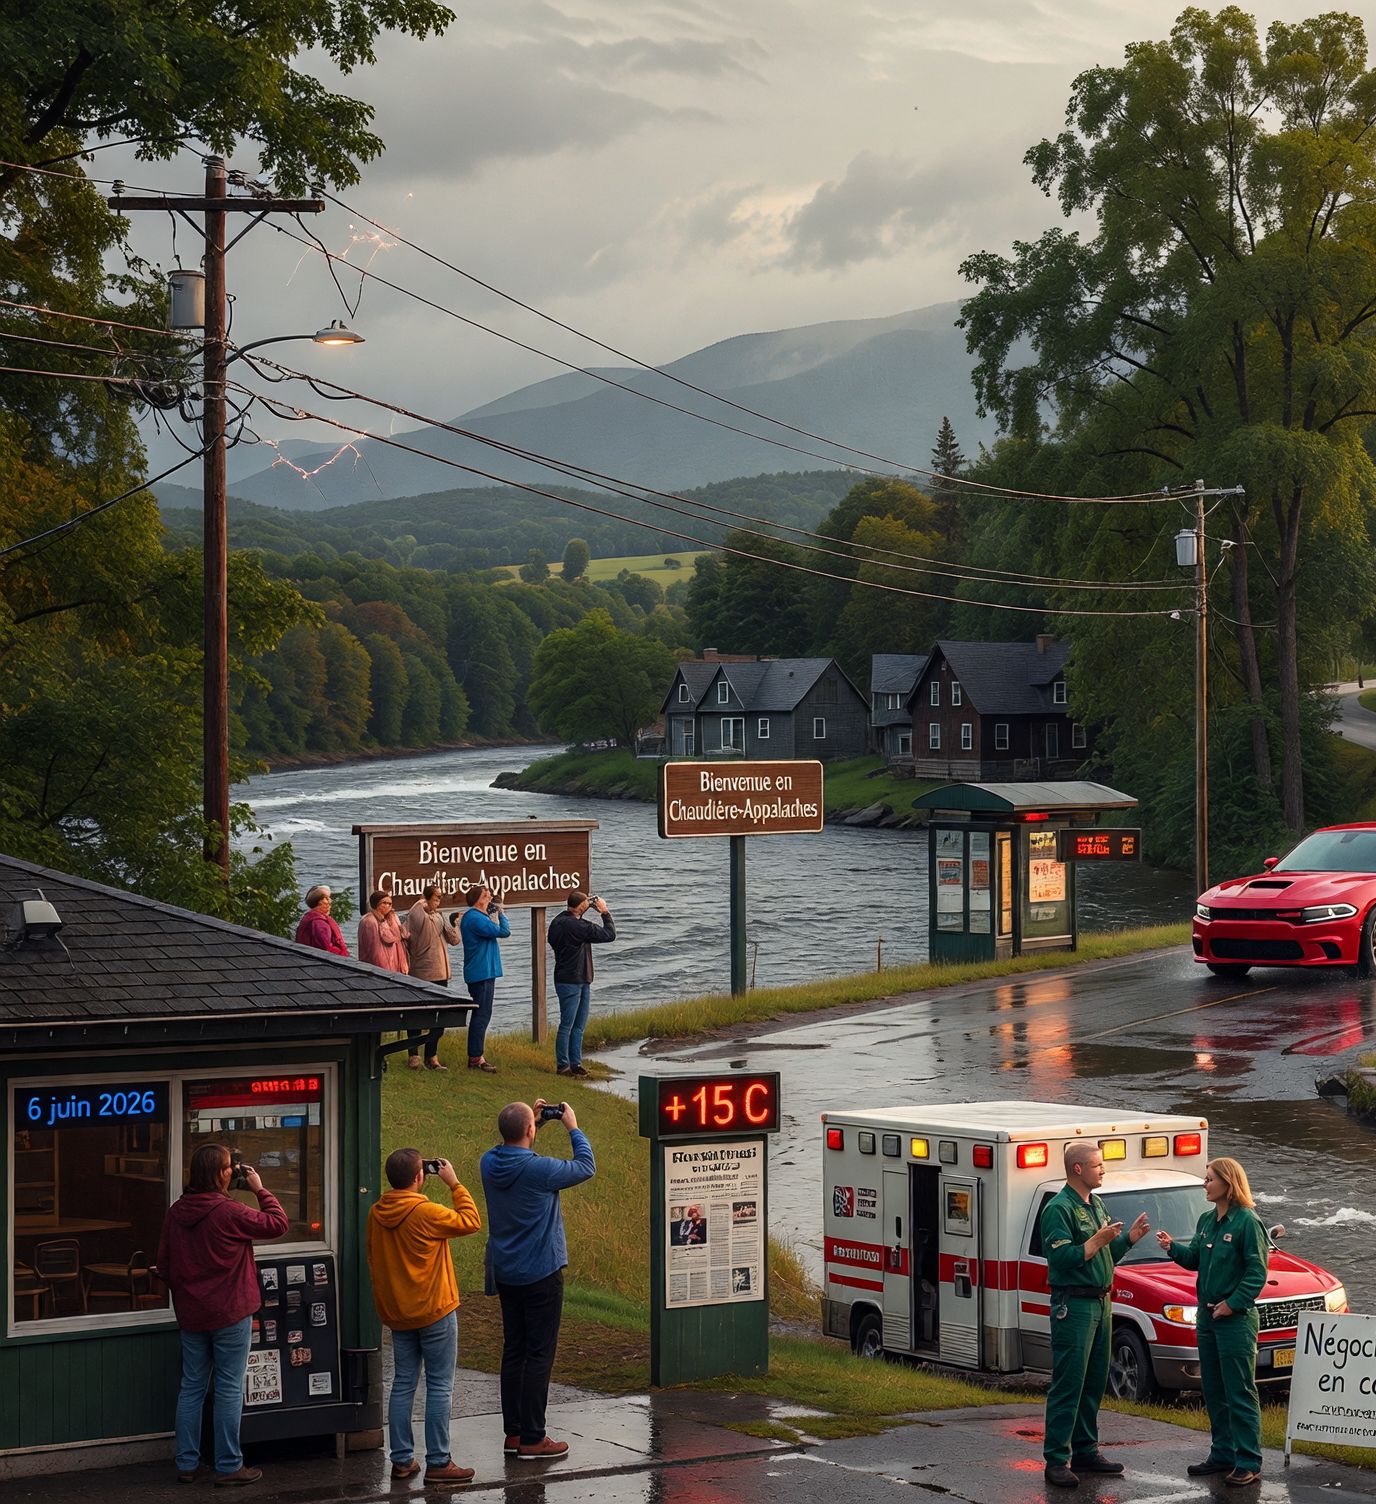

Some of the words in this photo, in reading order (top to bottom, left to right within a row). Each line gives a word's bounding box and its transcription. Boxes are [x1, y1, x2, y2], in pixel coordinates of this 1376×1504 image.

[700, 771, 771, 792] Bienvenue
[775, 776, 792, 791] en
[419, 840, 518, 864] Bienvenue
[524, 843, 546, 861] en
[28, 1097, 42, 1120] 6
[48, 1095, 91, 1125] juin
[99, 1091, 156, 1116] 2026
[745, 1083, 768, 1122] C
[1318, 1374, 1345, 1393] en
